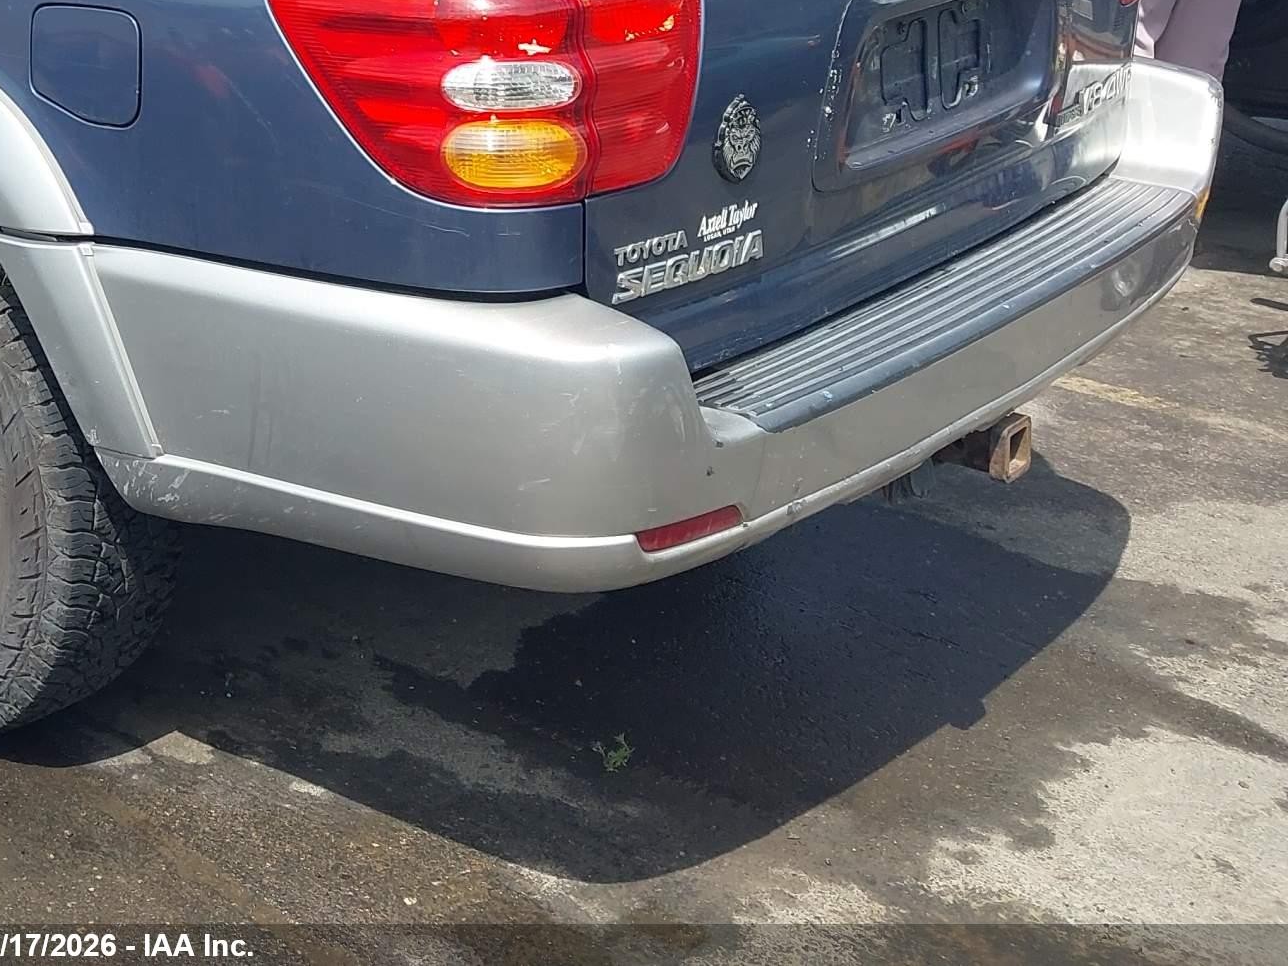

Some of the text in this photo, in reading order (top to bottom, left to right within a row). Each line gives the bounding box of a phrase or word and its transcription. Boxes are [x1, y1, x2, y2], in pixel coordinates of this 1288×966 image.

[697, 199, 758, 238] Axtell Taylor
[612, 230, 764, 305] SEQUOIA
[614, 230, 688, 266] TOYOTA
